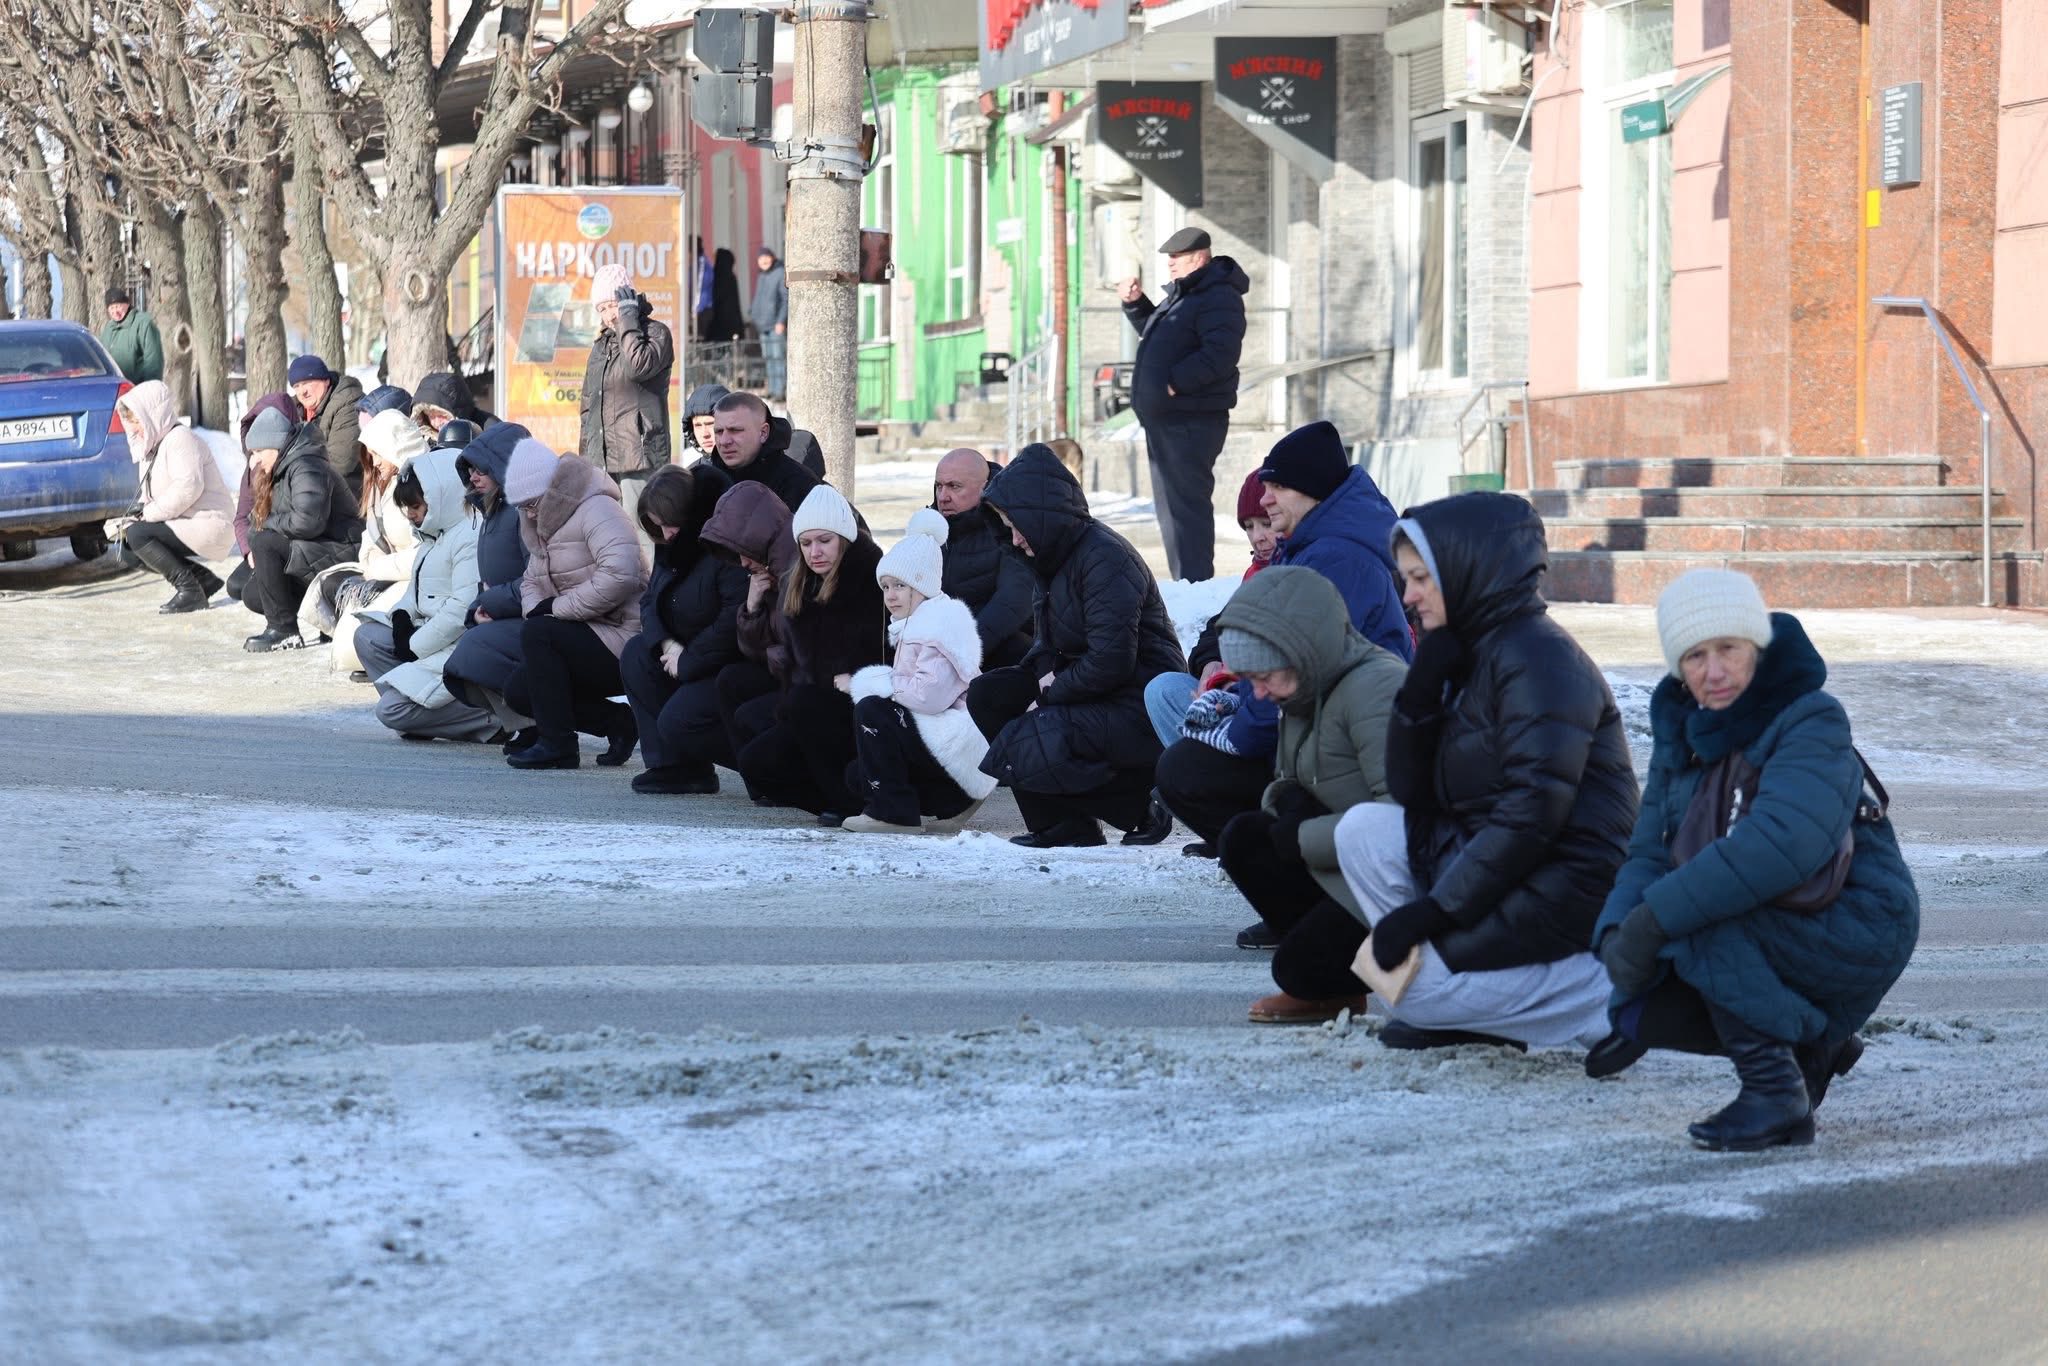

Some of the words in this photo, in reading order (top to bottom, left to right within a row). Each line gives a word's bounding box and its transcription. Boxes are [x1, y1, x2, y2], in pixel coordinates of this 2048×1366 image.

[1246, 113, 1277, 125] MEAT
[1282, 112, 1311, 125] SHOP
[1125, 151, 1152, 160] MEAT
[1157, 149, 1184, 160] SHOP
[515, 240, 673, 279] НАРКОЛОГ
[14, 420, 46, 437] 9894
